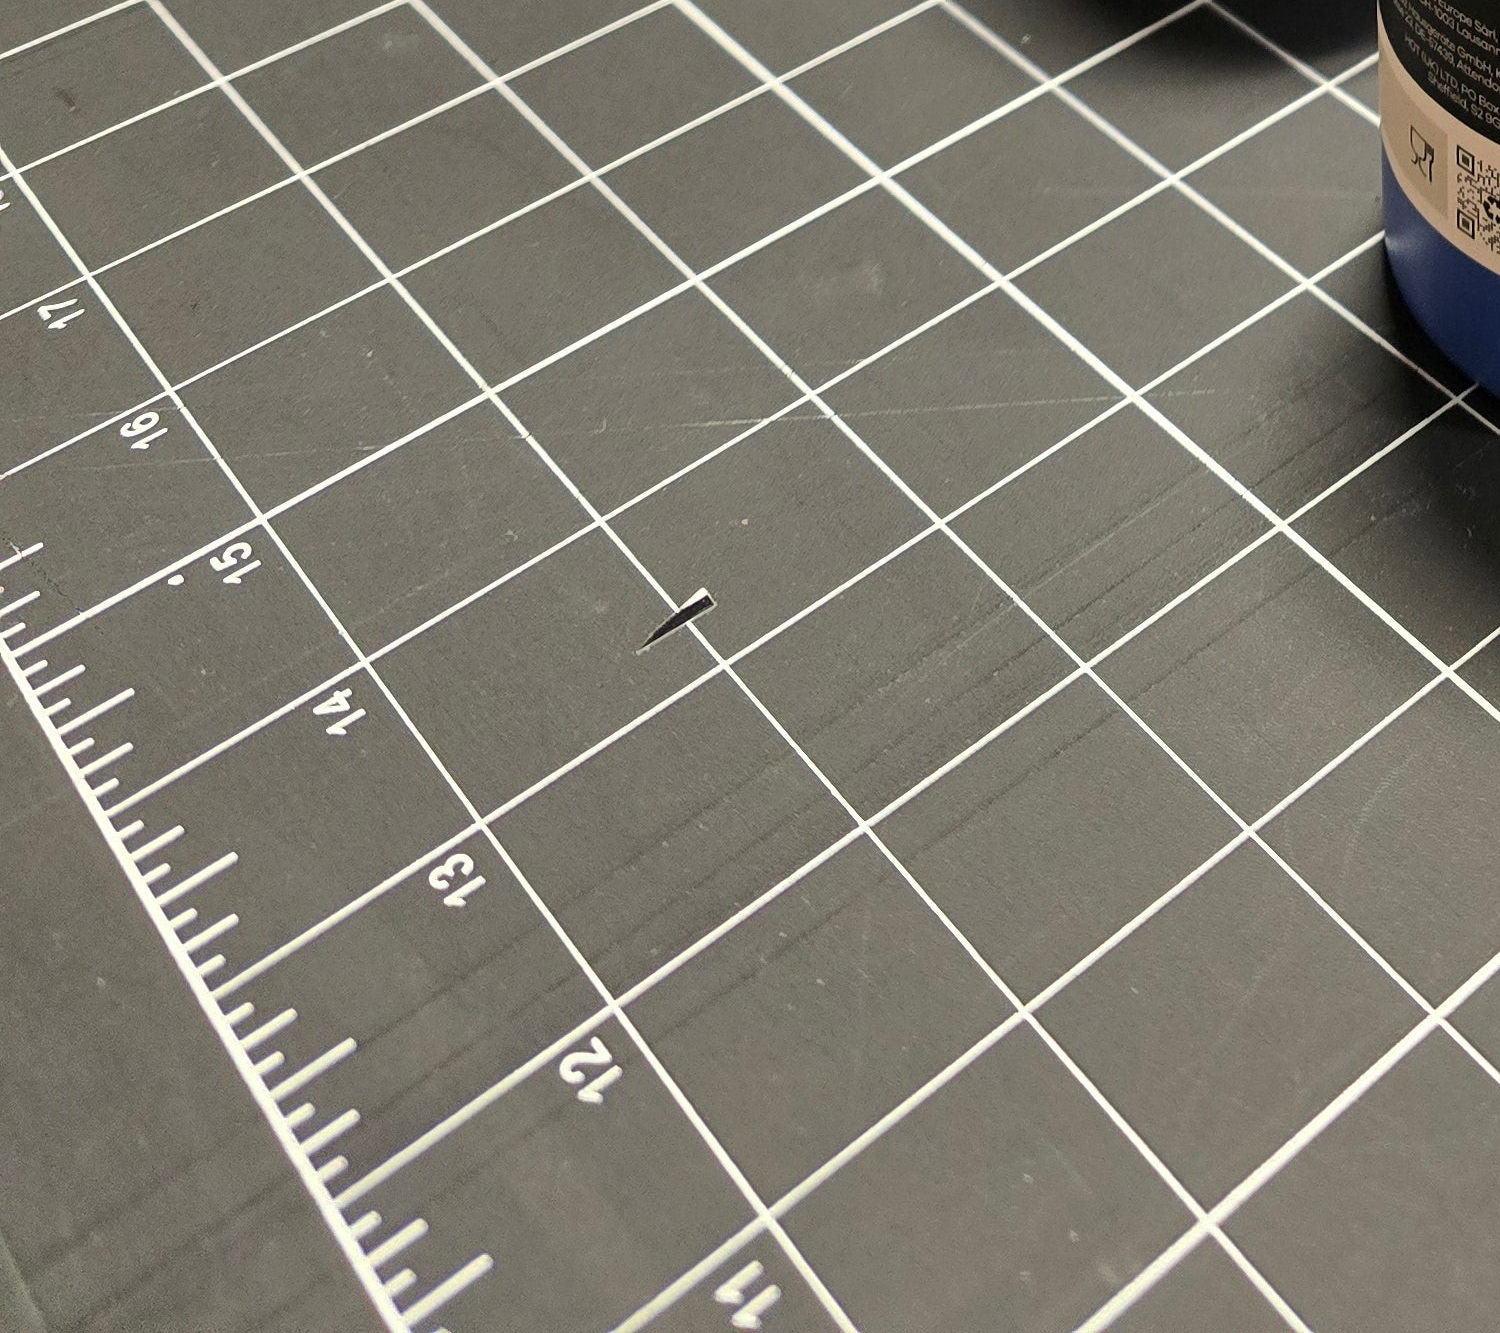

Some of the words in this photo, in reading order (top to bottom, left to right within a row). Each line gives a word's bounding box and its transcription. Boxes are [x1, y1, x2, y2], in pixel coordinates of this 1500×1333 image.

[1456, 44, 1494, 75] GmbH,
[1460, 83, 1477, 102] PO
[1478, 94, 1500, 115] Box
[1470, 104, 1484, 121] S2
[37, 297, 86, 330] 17
[119, 410, 169, 451] 16
[209, 541, 263, 585] 15
[312, 687, 367, 736] 14
[428, 852, 487, 908] 13
[558, 1035, 624, 1104] 12
[713, 1259, 783, 1330] 11
